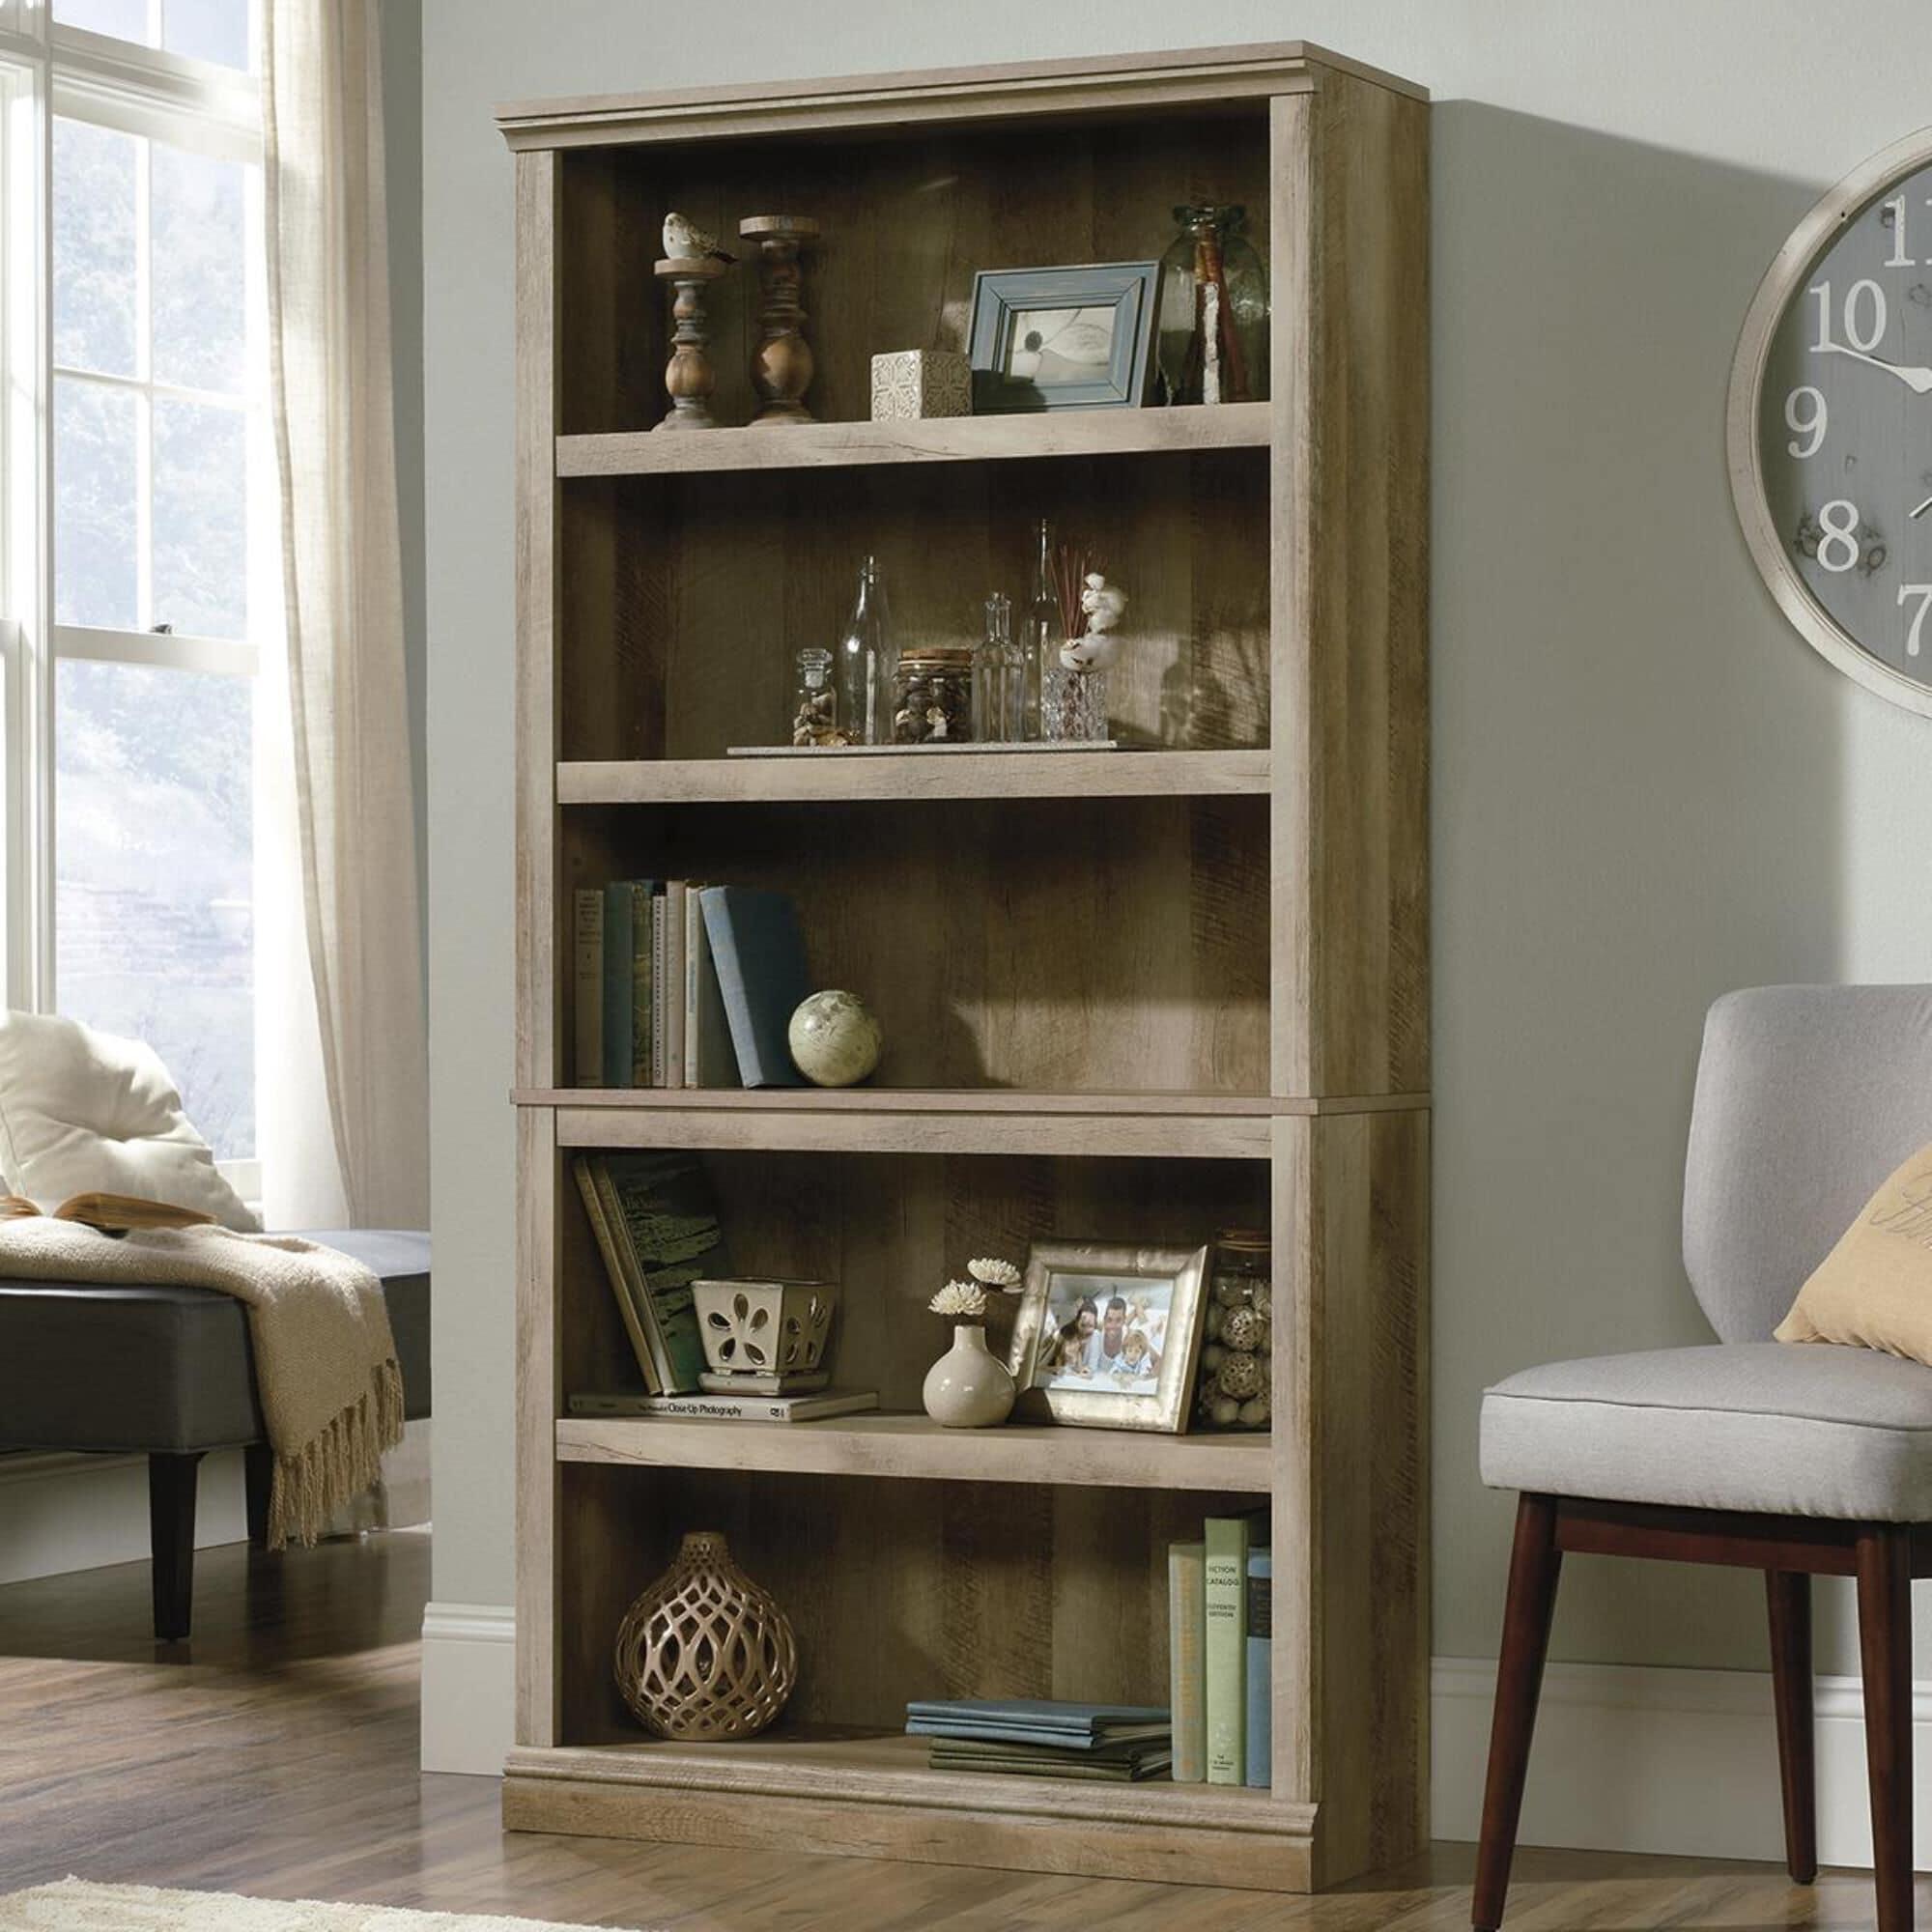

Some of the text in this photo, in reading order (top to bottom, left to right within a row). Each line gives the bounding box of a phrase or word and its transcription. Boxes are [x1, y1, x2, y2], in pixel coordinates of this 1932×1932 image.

[1884, 194, 1932, 267] 1
[1808, 278, 1887, 353] 10
[1784, 385, 1828, 459] 9
[1816, 499, 1860, 572] 8
[1897, 583, 1932, 657] 7
[698, 1404, 742, 1417] Photography
[1206, 1577, 1240, 1586] CATALOG
